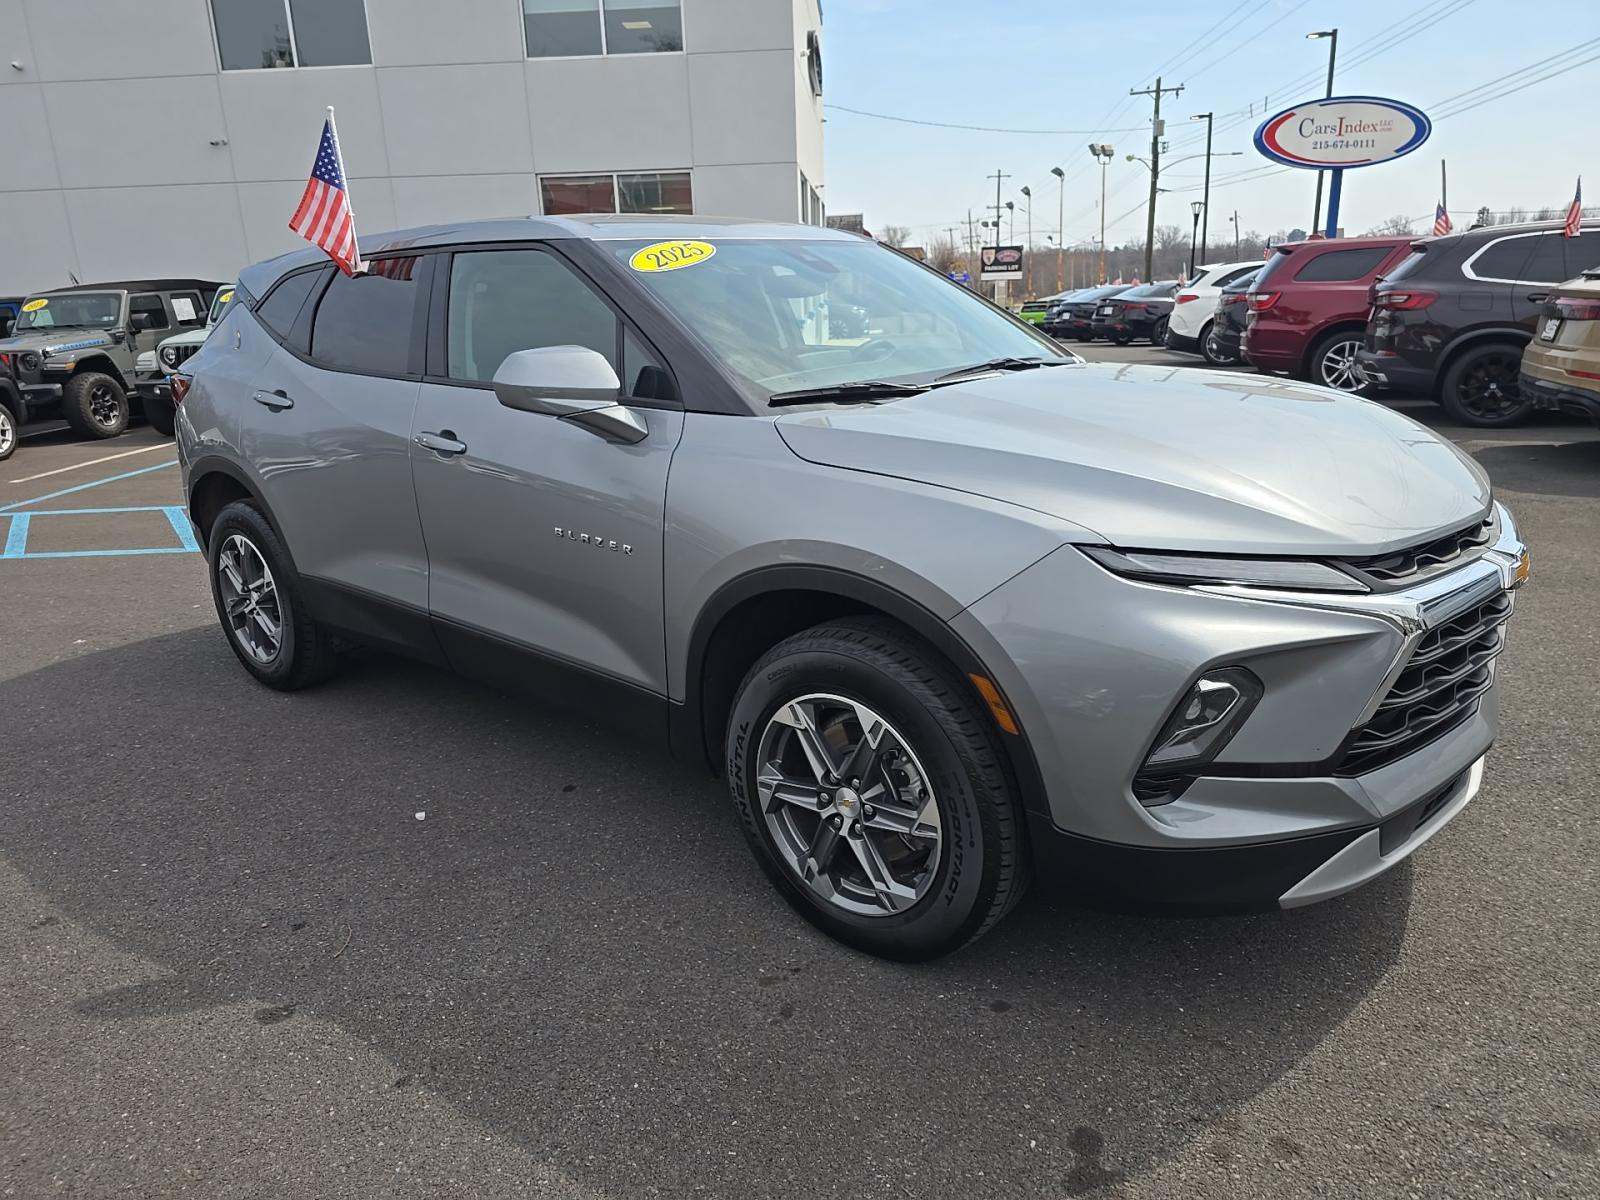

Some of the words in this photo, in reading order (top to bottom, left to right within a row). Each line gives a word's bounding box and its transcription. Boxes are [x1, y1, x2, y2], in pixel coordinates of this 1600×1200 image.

[1312, 139, 1375, 150] 215-674-0111
[646, 243, 704, 268] 2025
[555, 527, 632, 556] BLAZER
